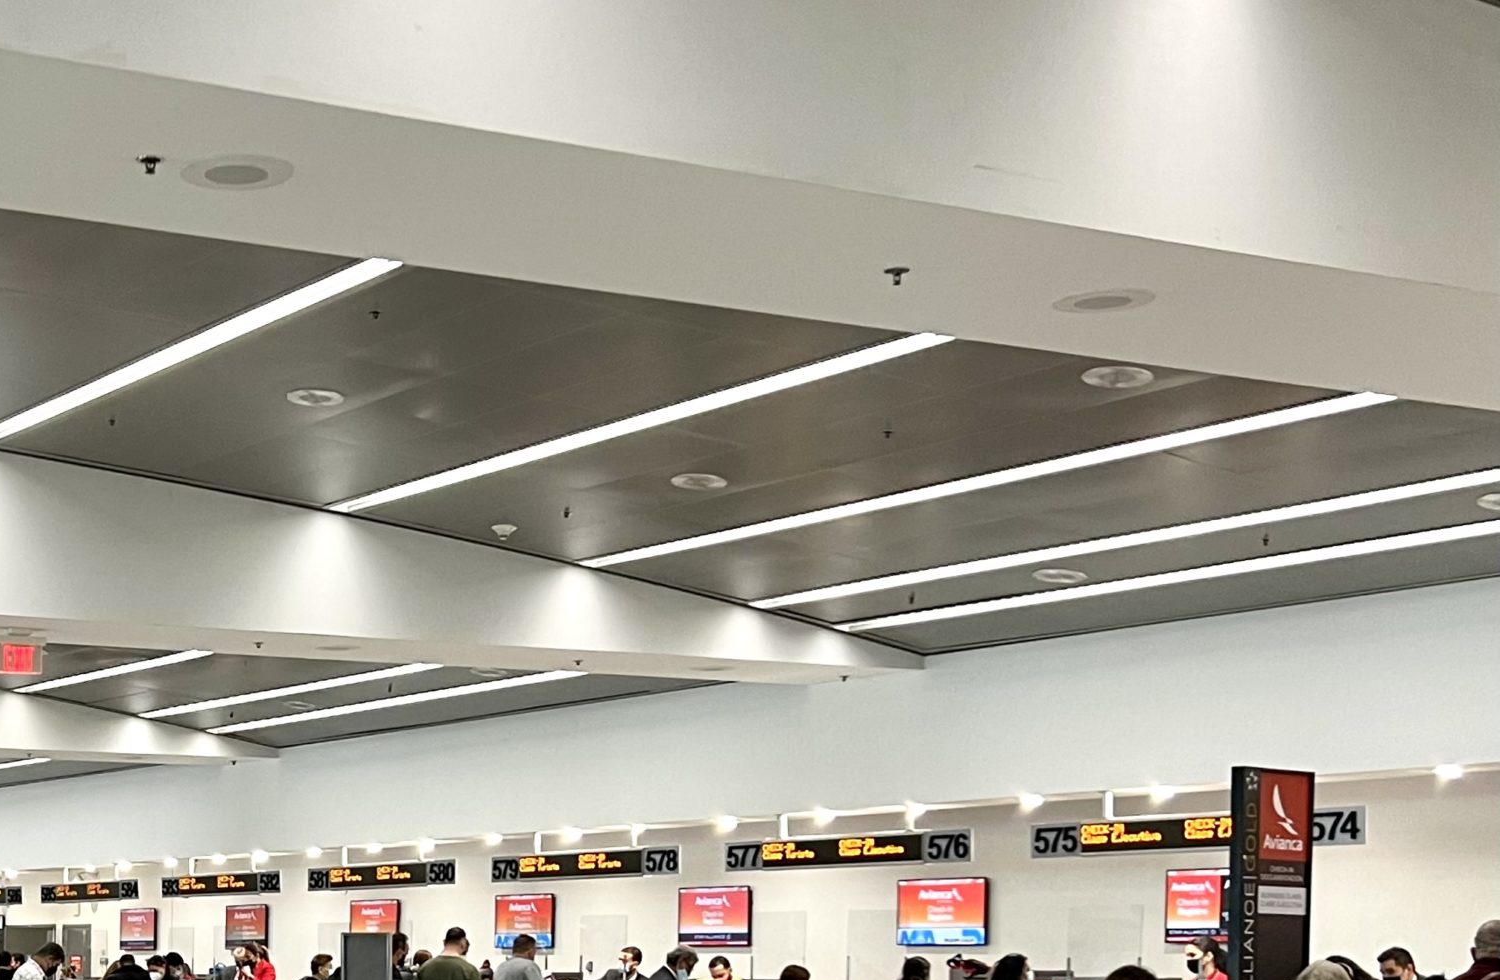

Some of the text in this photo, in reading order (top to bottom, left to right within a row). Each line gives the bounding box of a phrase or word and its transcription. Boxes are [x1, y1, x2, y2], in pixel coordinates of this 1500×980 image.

[927, 833, 968, 860] 576
[1034, 825, 1078, 854] 575
[1263, 834, 1303, 851] Avianca
[645, 849, 678, 872] 578
[726, 844, 759, 868] 577
[309, 870, 329, 889] 581
[429, 863, 455, 884] 580
[492, 859, 518, 880] 579
[260, 873, 280, 891] 582
